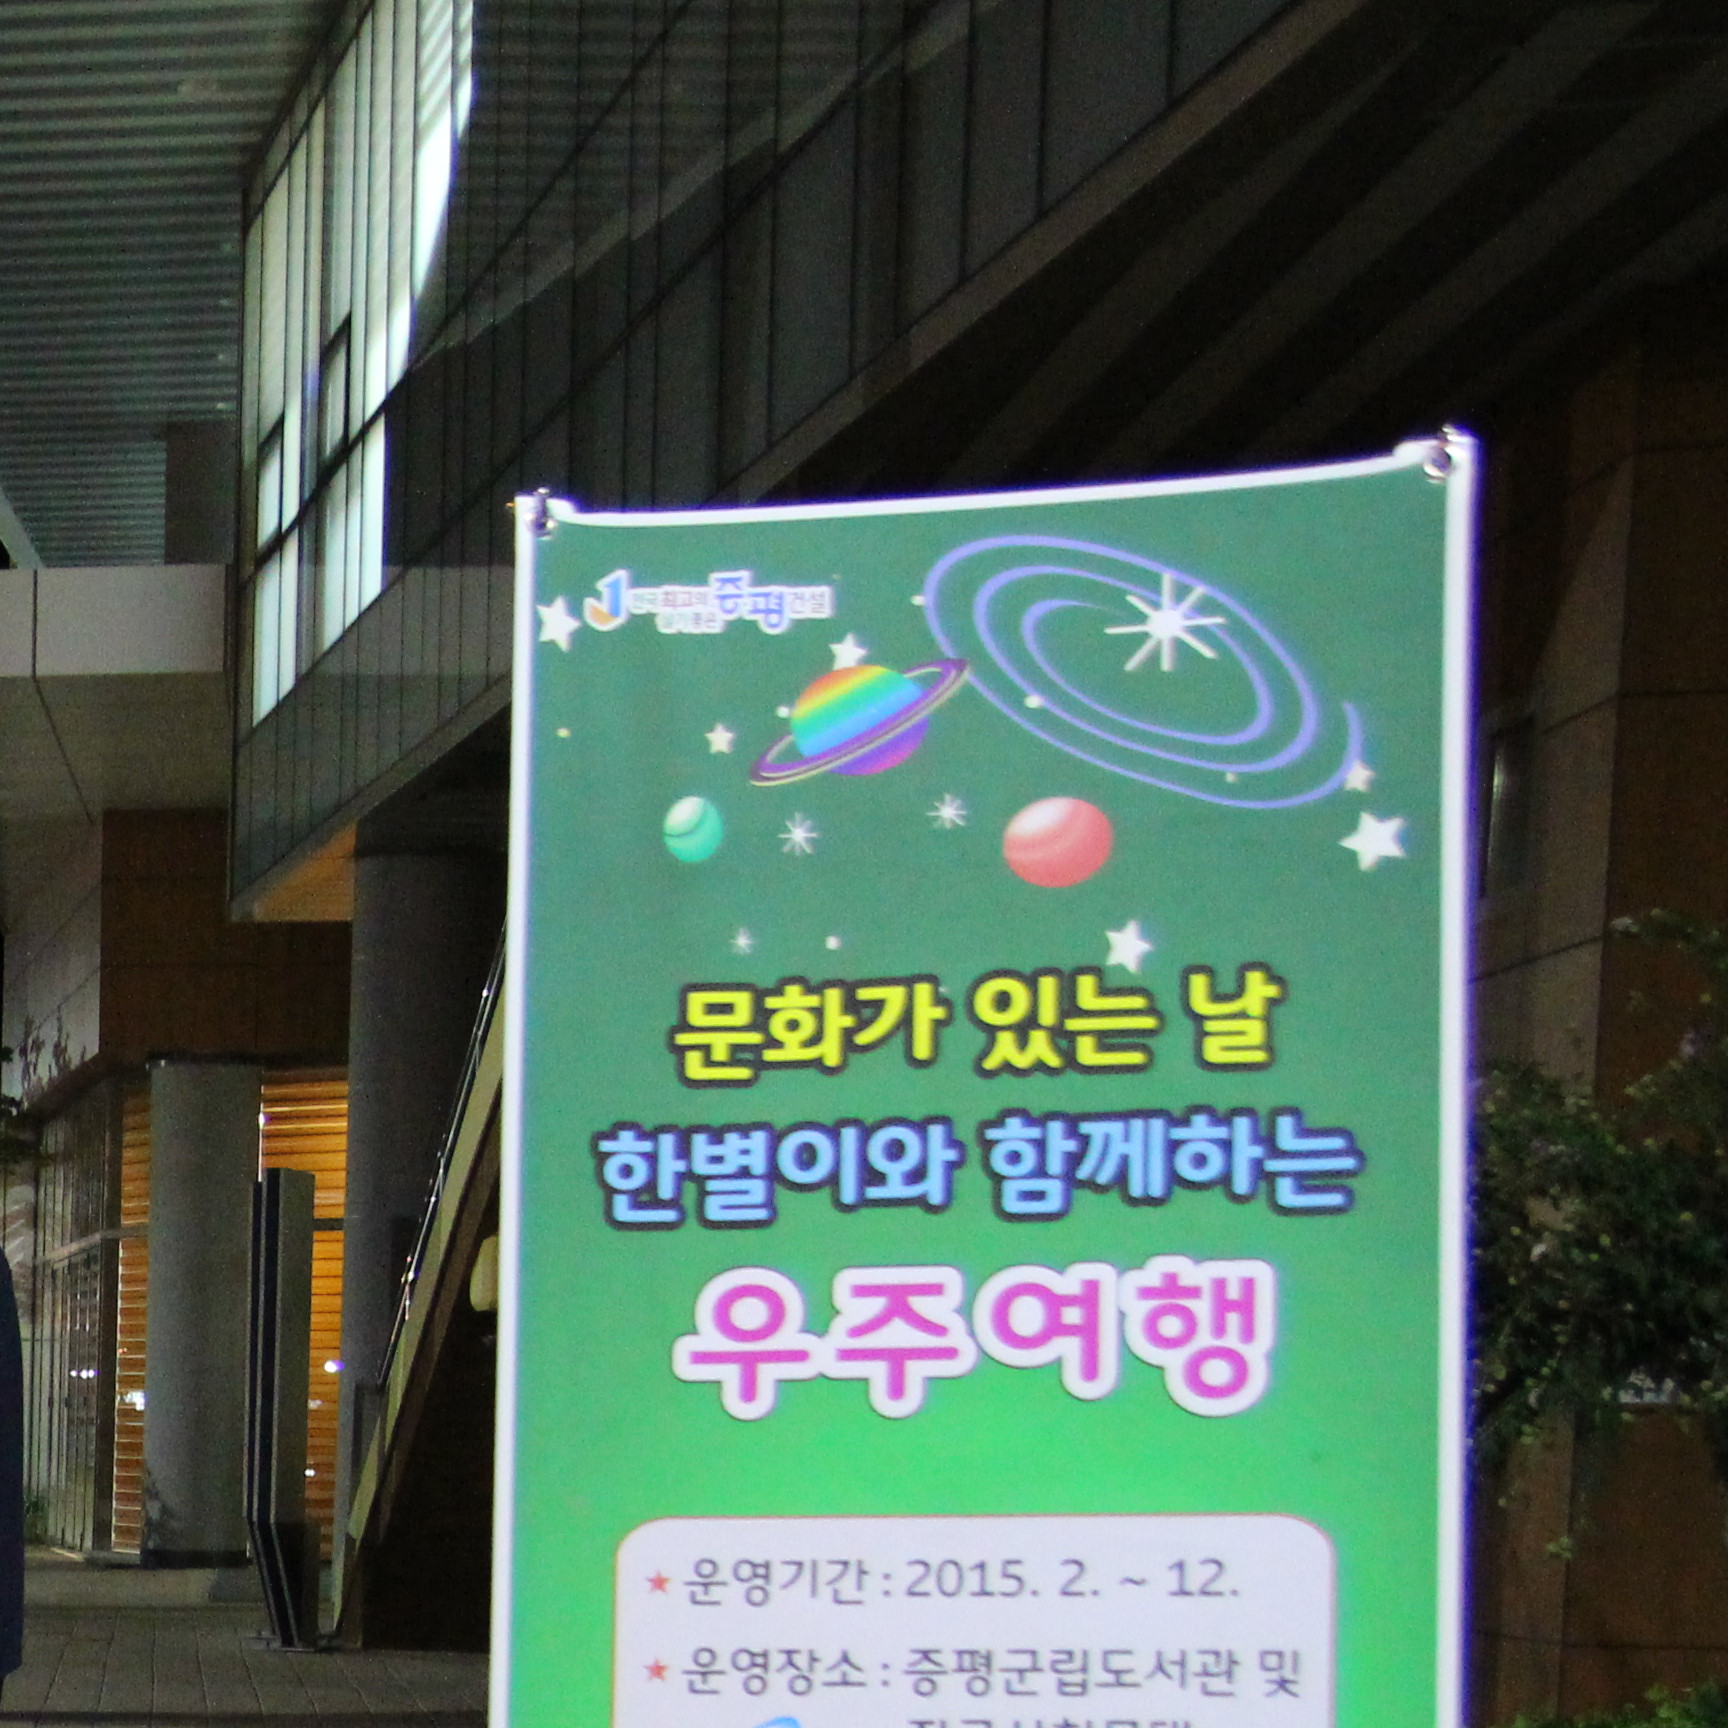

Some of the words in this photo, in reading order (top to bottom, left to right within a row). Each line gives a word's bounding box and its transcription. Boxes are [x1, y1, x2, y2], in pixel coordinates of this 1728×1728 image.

[671, 977, 950, 1084] 문화가
[969, 969, 1162, 1073] 있는
[1185, 966, 1284, 1068] 날
[595, 1120, 962, 1226] 한별이와
[982, 1110, 1362, 1218] 함께하는
[682, 1263, 1264, 1411] 우주여행
[1167, 1557, 1239, 1597] 12.
[903, 1647, 1241, 1698] 증평군립도서관
[1258, 1647, 1301, 1698] 및
